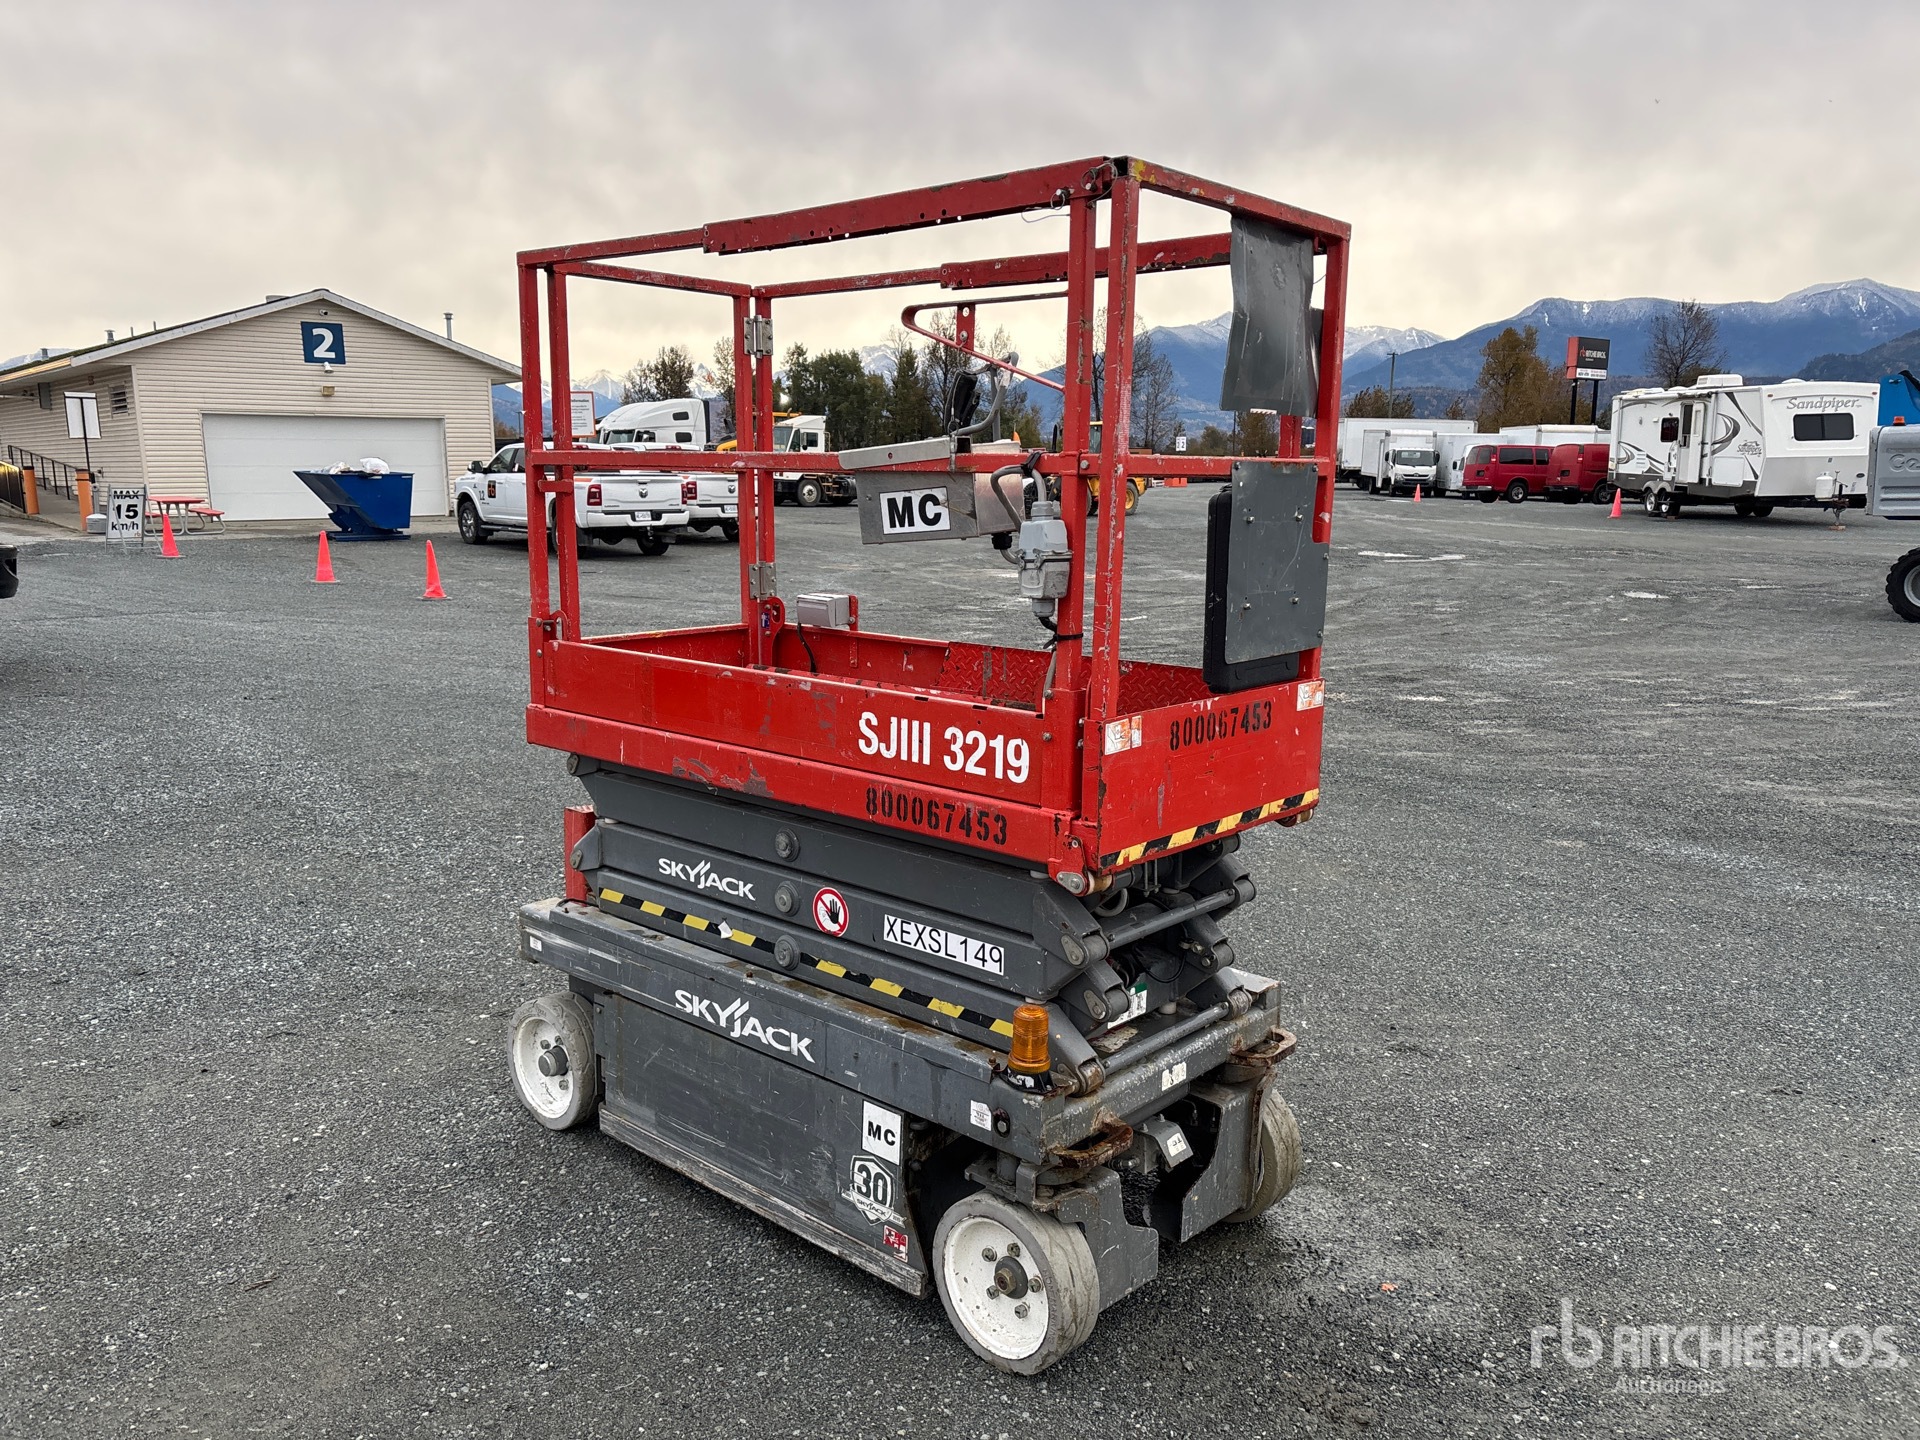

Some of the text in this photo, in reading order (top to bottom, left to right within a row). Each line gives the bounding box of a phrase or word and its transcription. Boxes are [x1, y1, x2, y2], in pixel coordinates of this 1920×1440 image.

[312, 327, 336, 359] 2
[1786, 396, 1860, 412] Sandpiper
[113, 490, 140, 500] MAX
[115, 503, 139, 520] 15
[886, 493, 942, 529] MC
[111, 521, 139, 531] km/h
[1169, 700, 1272, 751] 800067453
[858, 711, 1030, 784] SJIII 3219
[865, 787, 1007, 845] 800067453
[658, 857, 756, 901] SKYJACK
[886, 915, 1004, 974] XEXSL149
[674, 988, 816, 1063] SKYJACK
[867, 1120, 896, 1147] MC
[856, 1163, 889, 1207] 30
